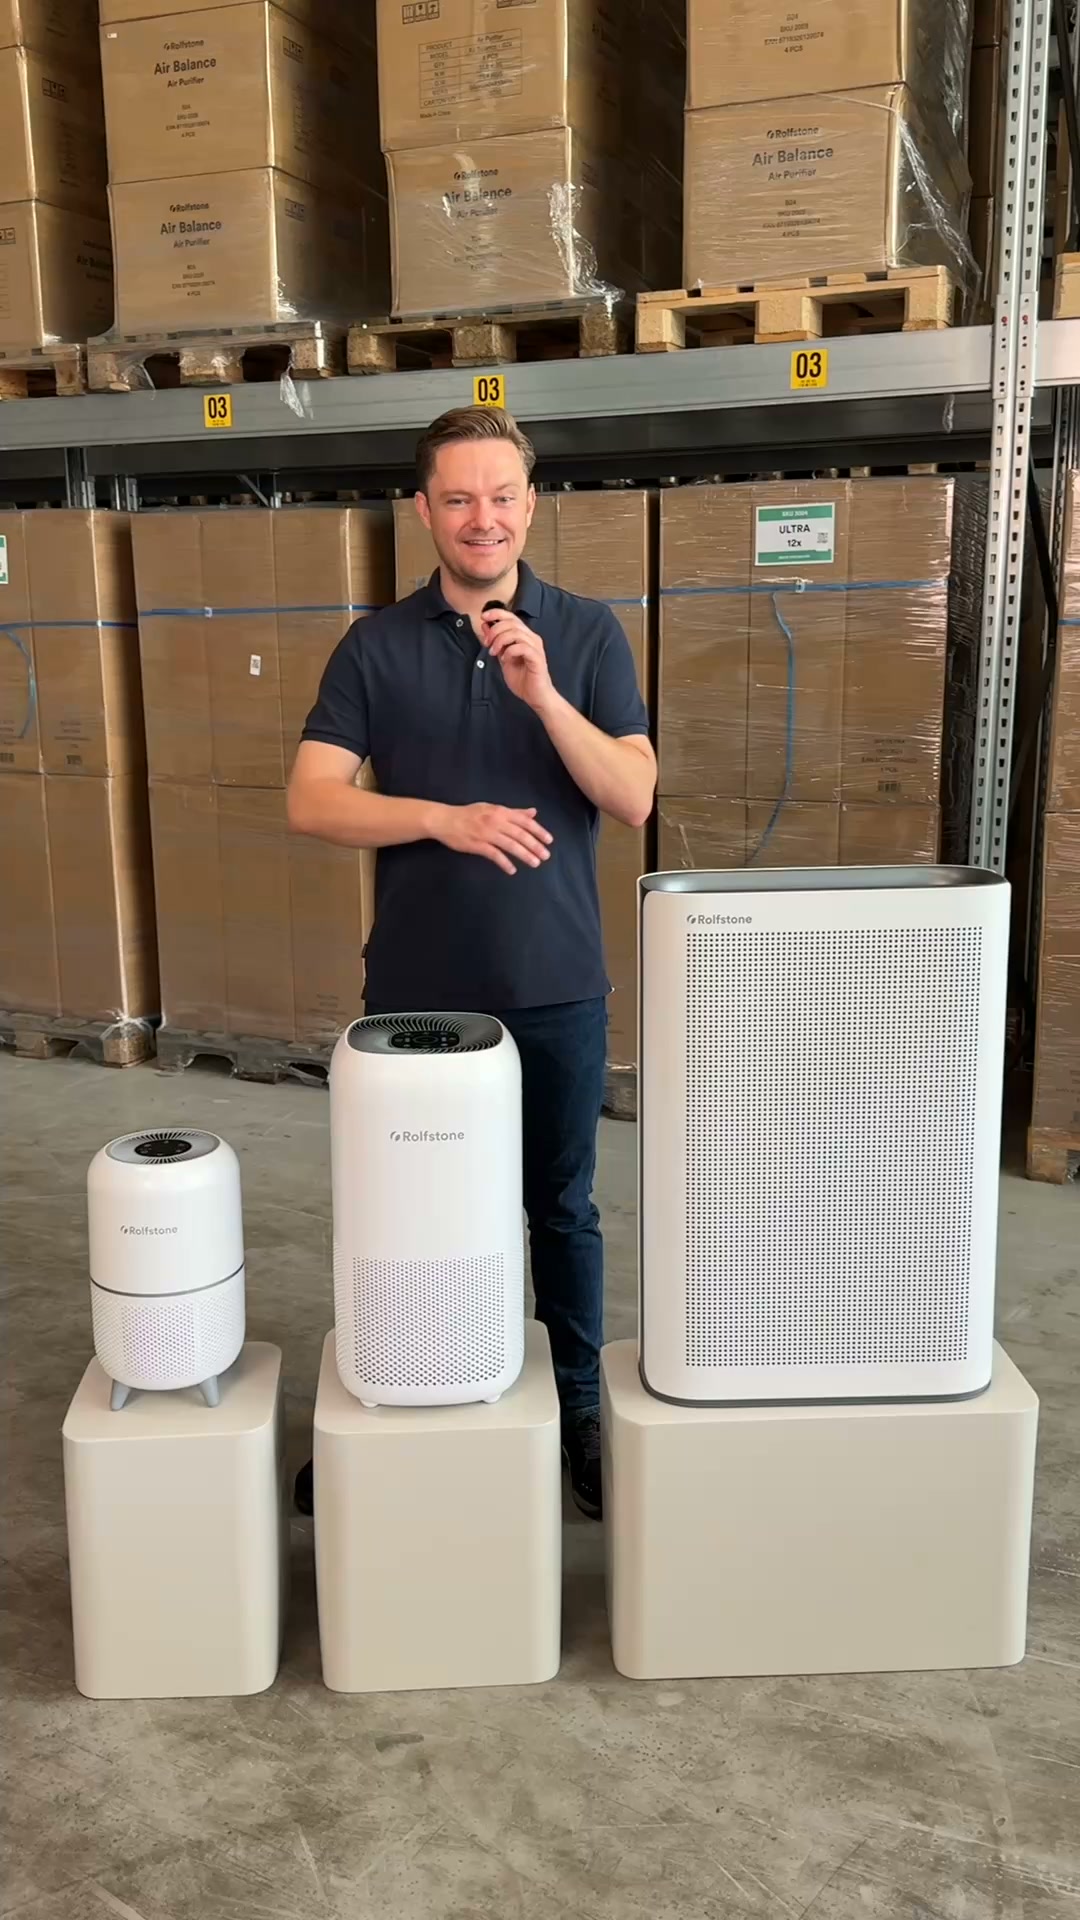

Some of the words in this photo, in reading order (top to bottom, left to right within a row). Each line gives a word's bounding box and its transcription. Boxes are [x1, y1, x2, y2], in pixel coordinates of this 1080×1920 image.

[171, 39, 205, 50] Rolfstone
[154, 62, 171, 75] Air
[173, 58, 217, 72] Balance
[167, 80, 178, 88] Air
[179, 77, 204, 86] Purifier
[775, 127, 819, 139] Rolfstone
[752, 151, 774, 167] Air
[777, 147, 834, 163] Balance
[768, 171, 782, 181] Air
[783, 168, 817, 179] Purifier
[443, 191, 461, 204] Air
[176, 203, 210, 213] Rolfstone
[160, 222, 176, 235] Air
[179, 220, 222, 234] Balance
[173, 240, 184, 248] Air
[796, 352, 822, 379] 03
[478, 377, 500, 402] 03
[208, 396, 227, 419] 03
[779, 524, 811, 534] ULTRA
[787, 539, 802, 547] 12x
[697, 914, 753, 925] Rolfstone
[402, 1130, 465, 1142] Rolfstone
[129, 1226, 178, 1236] Rolfstone
